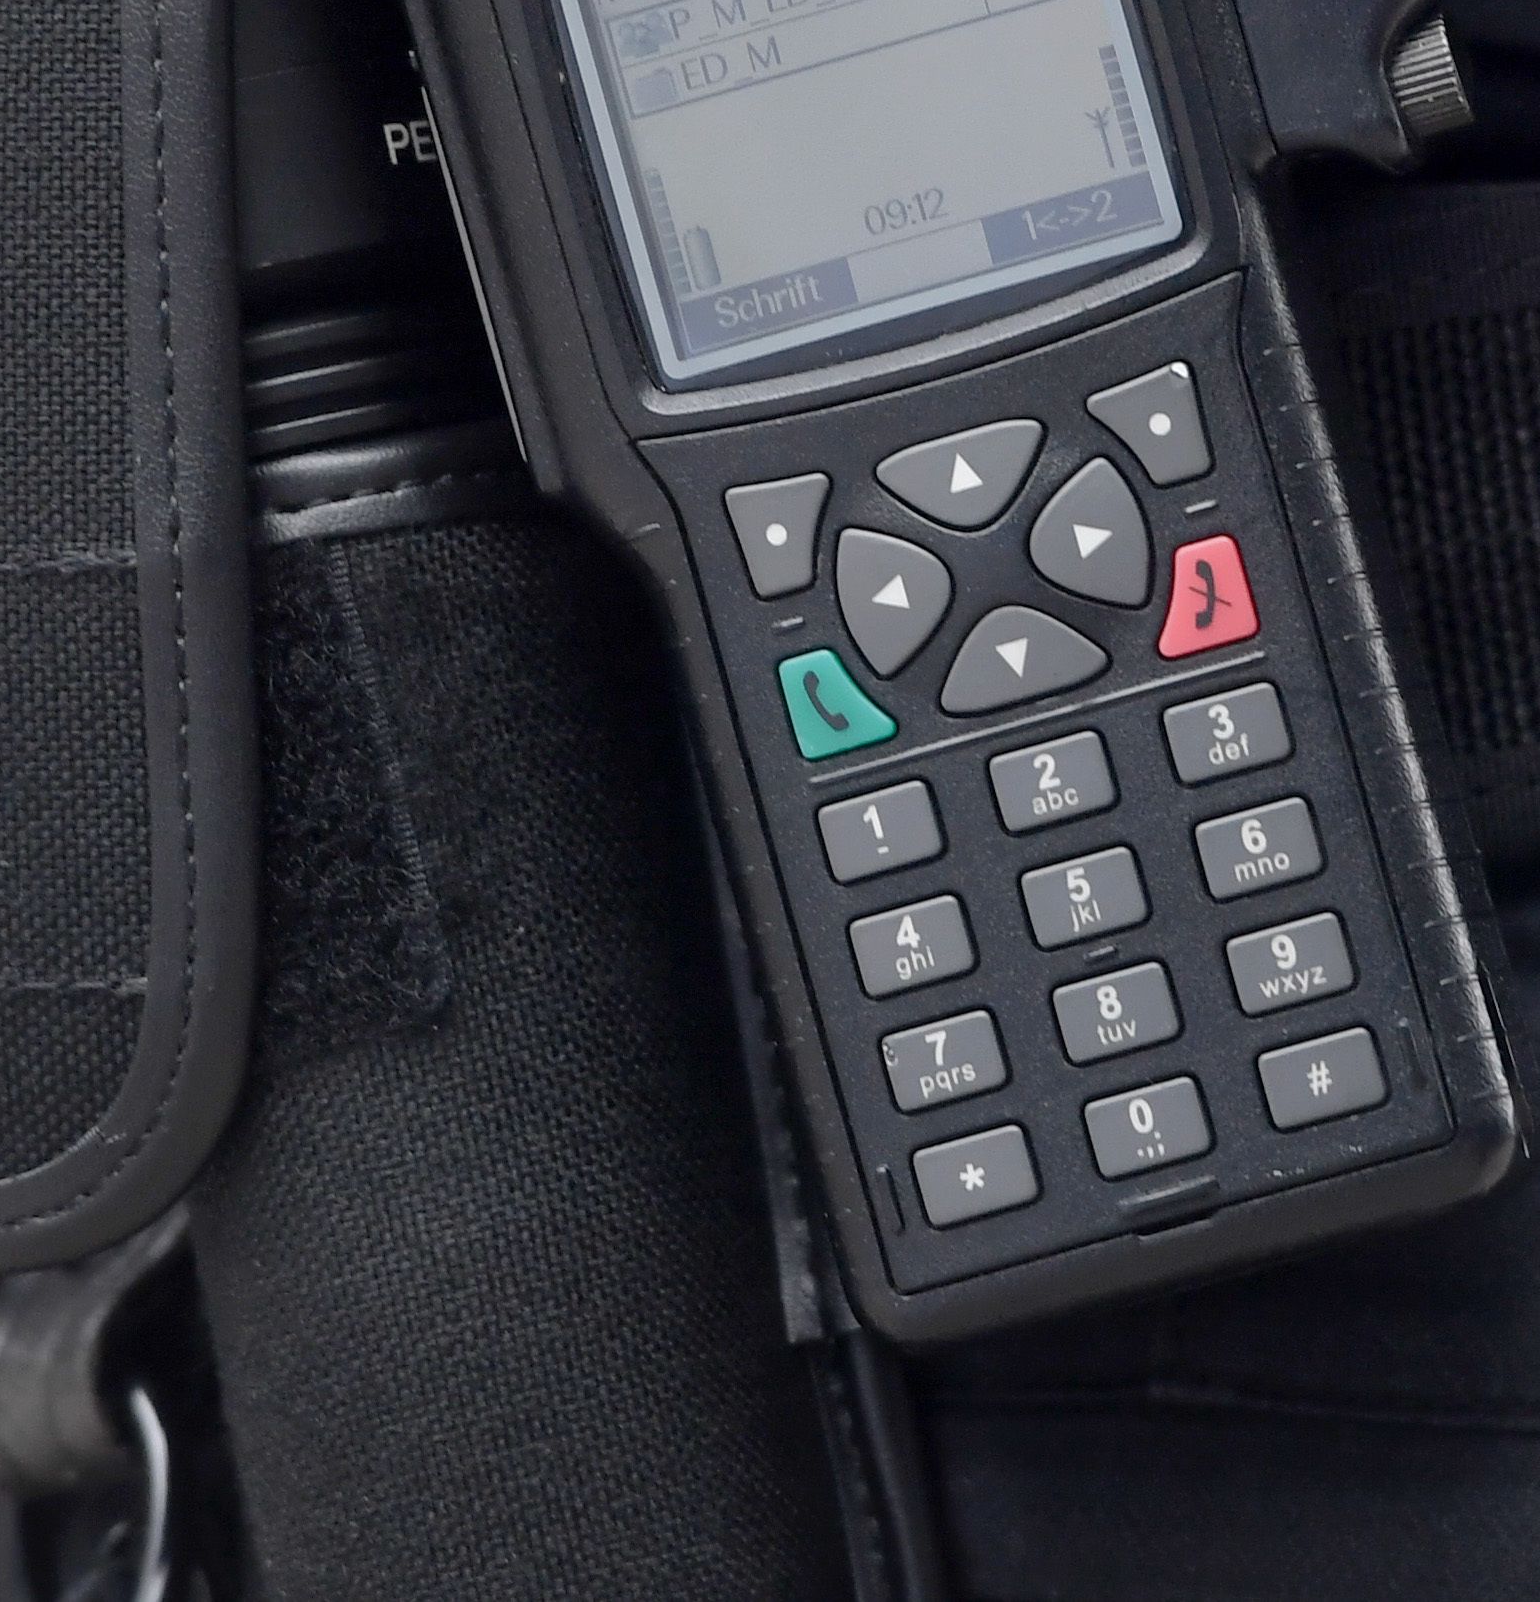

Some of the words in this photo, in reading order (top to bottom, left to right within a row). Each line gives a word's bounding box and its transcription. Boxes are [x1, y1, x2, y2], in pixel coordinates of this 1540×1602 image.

[863, 187, 950, 236] 09:12
[713, 274, 824, 329] Schrift
[1208, 704, 1235, 740] 3
[1208, 733, 1250, 766] def
[1033, 753, 1061, 791] 2
[1032, 788, 1079, 815] abc
[863, 804, 884, 839] 1
[1241, 819, 1267, 854] 6
[1066, 866, 1091, 903] 5
[1234, 852, 1290, 882] mno
[896, 915, 921, 949] 4
[1070, 899, 1101, 933] jkl
[895, 948, 935, 980] ghi
[1271, 934, 1297, 970] 9
[1259, 966, 1327, 1000] wxyz
[1096, 985, 1122, 1020] 8
[924, 1030, 948, 1066] 7
[1097, 1019, 1136, 1045] tuv
[919, 1062, 976, 1099] pqrs
[1128, 1098, 1154, 1134] 0
